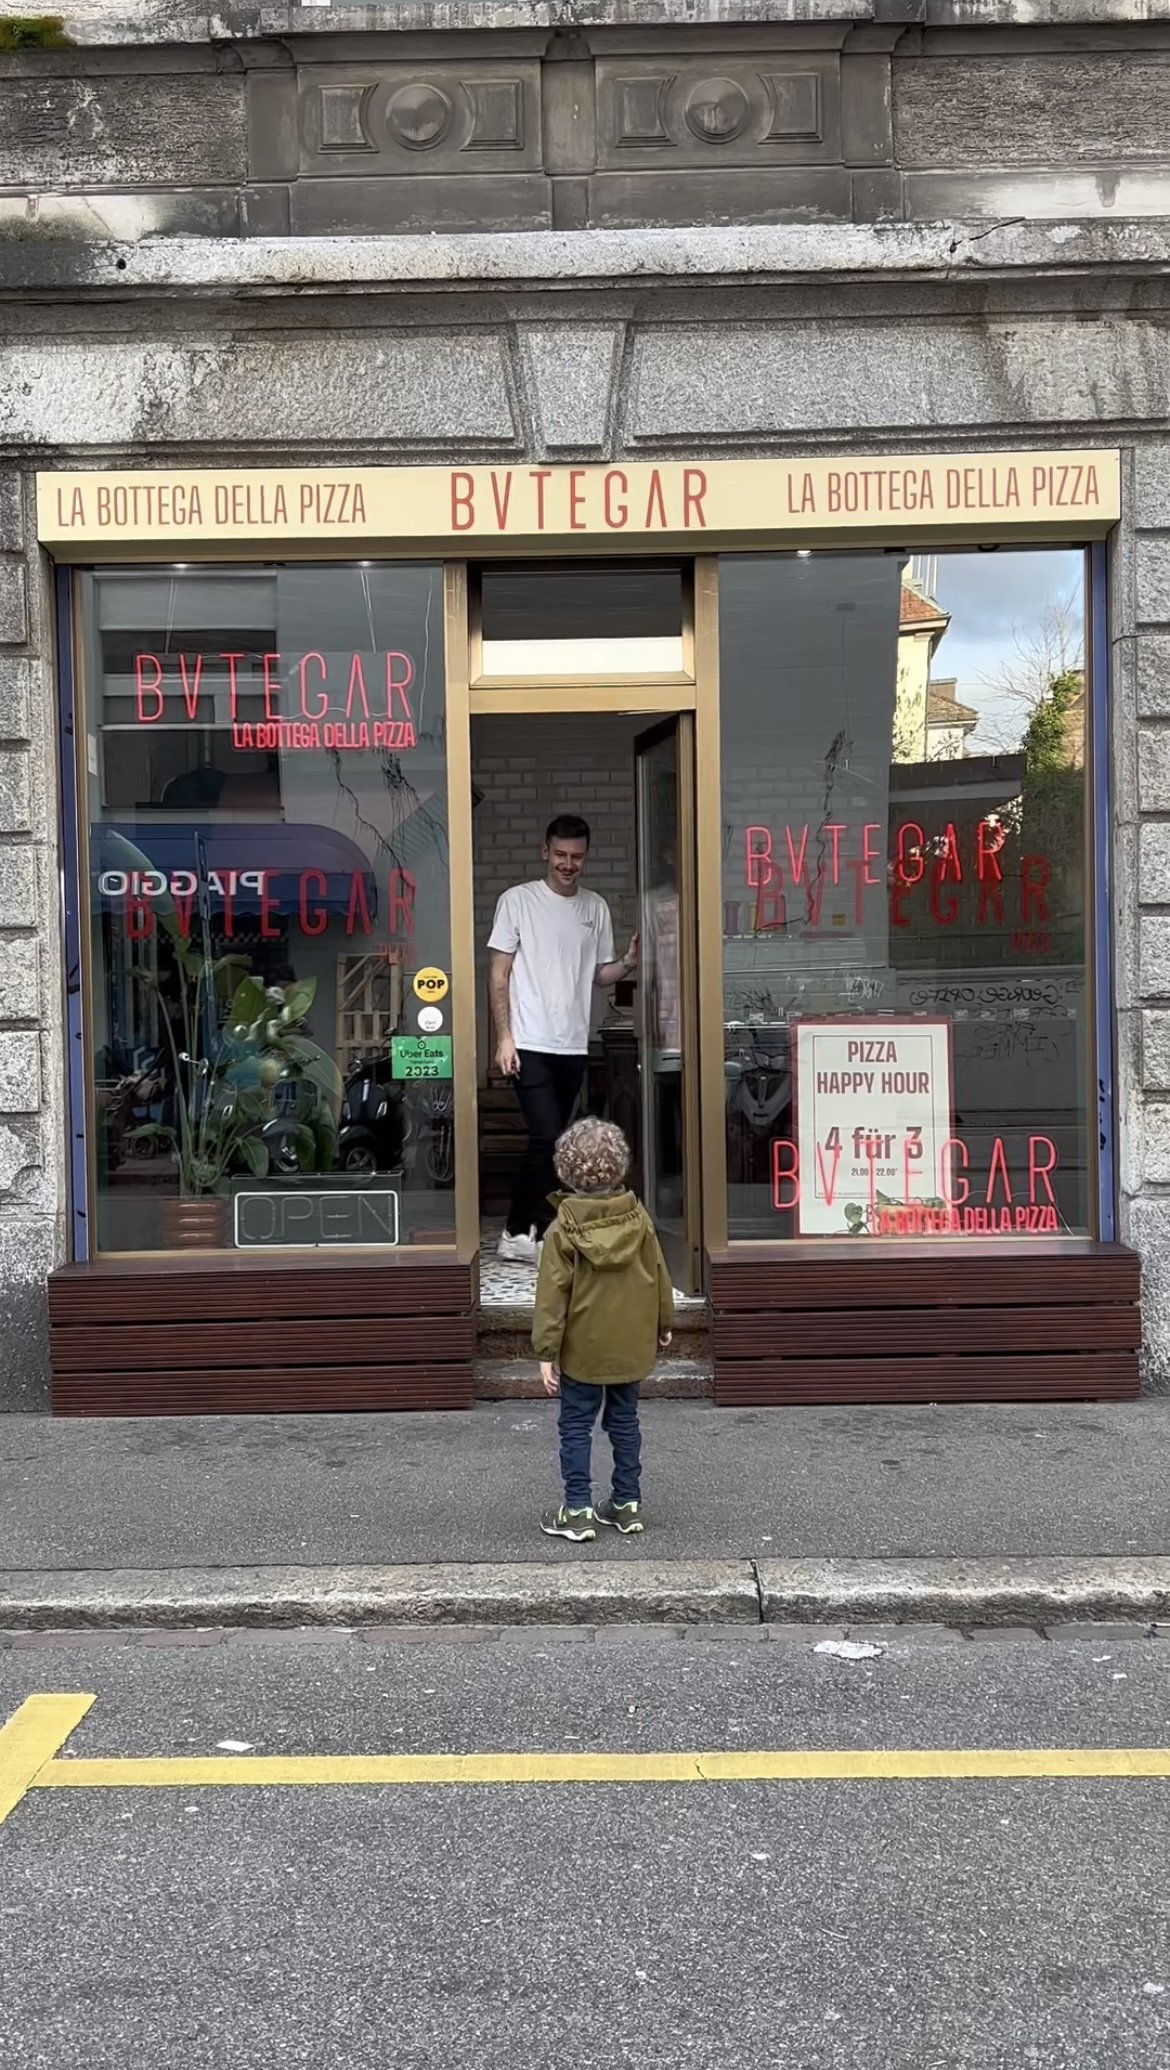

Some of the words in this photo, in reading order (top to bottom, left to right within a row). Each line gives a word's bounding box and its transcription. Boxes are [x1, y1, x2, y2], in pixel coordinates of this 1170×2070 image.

[787, 472, 816, 513] LA
[827, 468, 934, 513] BOTTEGA
[946, 466, 1020, 509] DELLA
[1032, 464, 1100, 507] PIZZA
[57, 486, 86, 527] LA
[97, 484, 203, 527] BOTTEGA
[214, 483, 288, 525] DELLA
[299, 482, 367, 524] PIZZA
[233, 721, 252, 748] LA
[255, 721, 321, 748] BOTTEGA
[323, 721, 370, 748] DELLA
[373, 720, 416, 748] PIZZA
[417, 979, 445, 990] POP
[400, 1049, 423, 1058] Uber
[424, 1048, 444, 1058] Eats
[847, 1040, 898, 1063] PIZZA
[405, 1065, 439, 1077] 2023
[816, 1071, 875, 1094] HAPPY
[881, 1071, 930, 1094] HOUR
[824, 1126, 843, 1159] 4
[851, 1126, 897, 1160] für
[905, 1126, 924, 1159] 3
[850, 1167, 870, 1177] 21.00
[240, 1195, 393, 1240] OPEN
[963, 1205, 1012, 1235] DELLA
[1015, 1204, 1059, 1233] PIZZA
